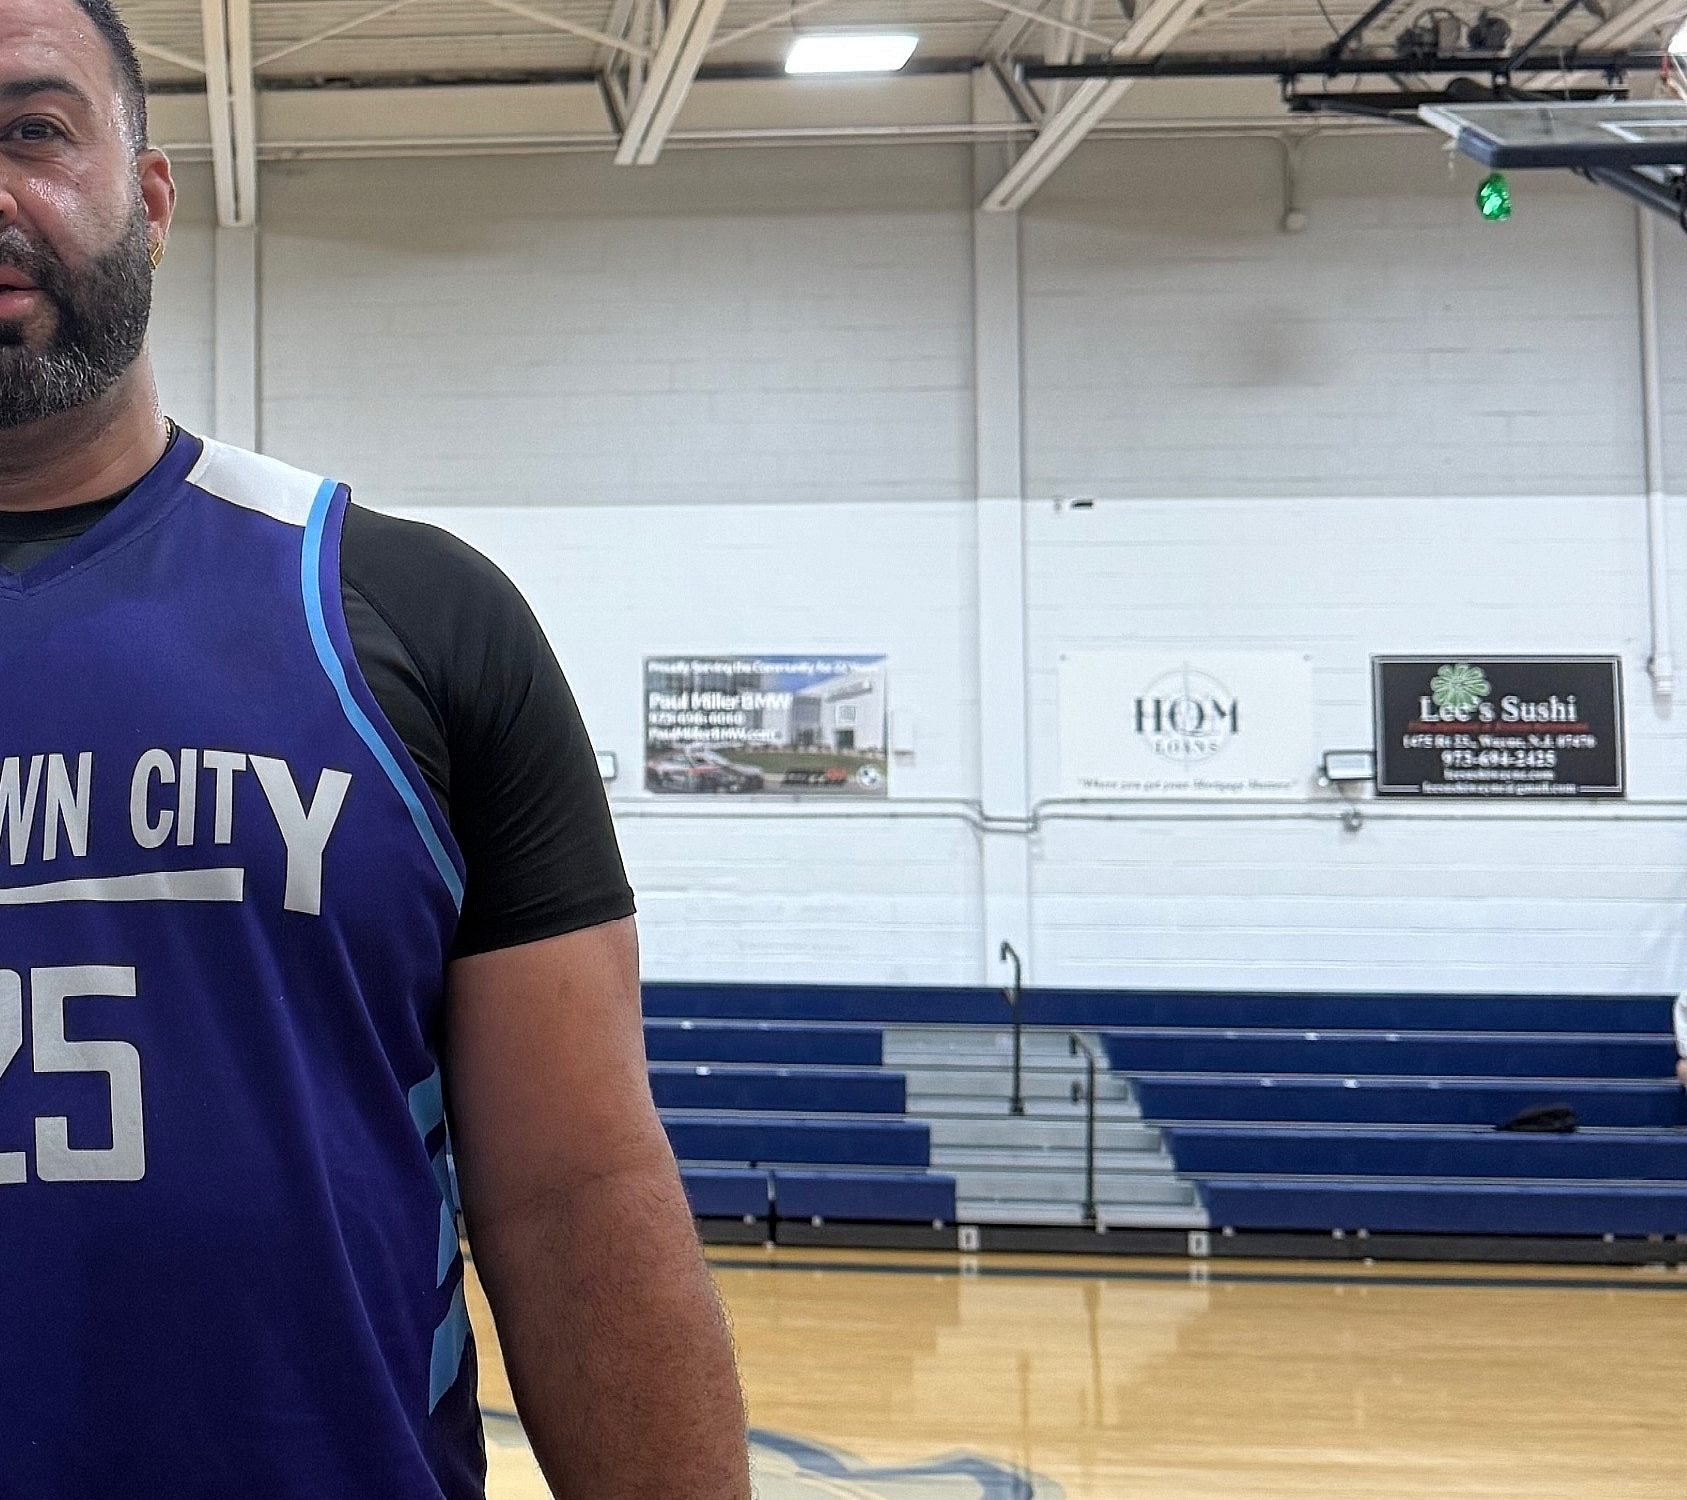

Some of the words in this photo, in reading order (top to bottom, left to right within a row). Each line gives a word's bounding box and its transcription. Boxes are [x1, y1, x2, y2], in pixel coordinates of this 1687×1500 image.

[648, 692, 689, 711] Paul
[691, 692, 739, 711] Miller
[741, 692, 795, 711] BMW
[1419, 695, 1496, 722] Lee's
[1501, 694, 1579, 722] Sushi
[130, 748, 353, 916] CITY
